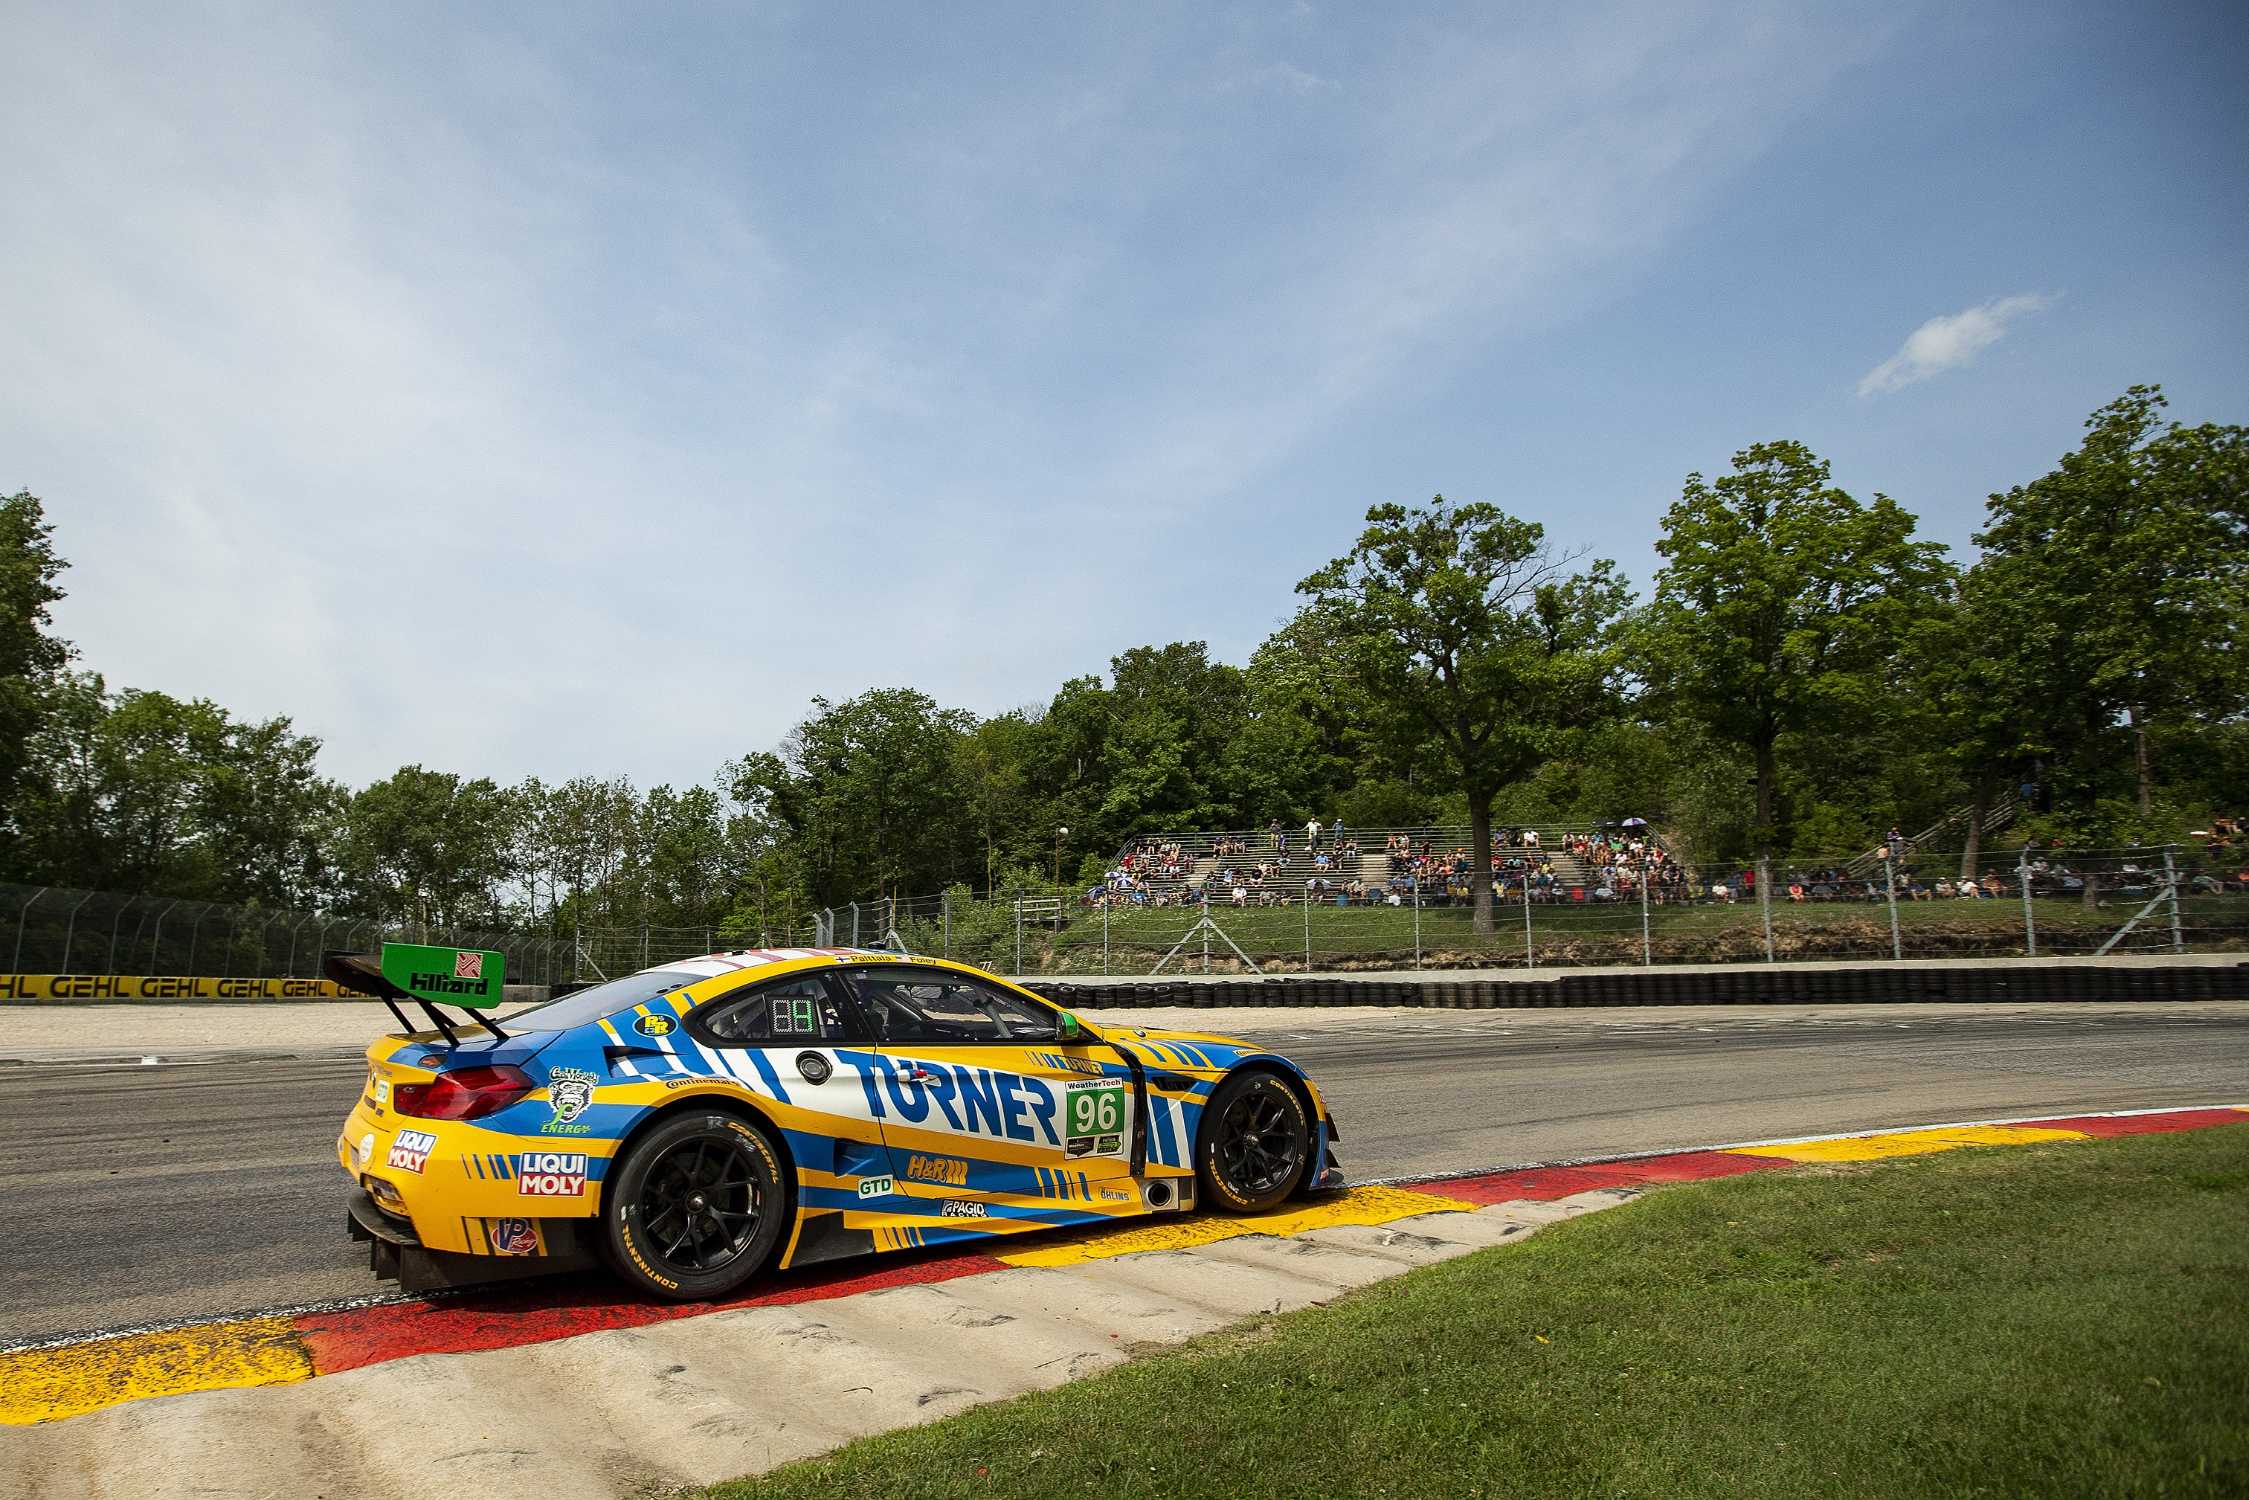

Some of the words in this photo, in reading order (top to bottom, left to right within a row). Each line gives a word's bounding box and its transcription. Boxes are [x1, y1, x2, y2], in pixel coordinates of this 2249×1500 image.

[51, 976, 129, 998] GEHL
[140, 977, 208, 998] GEHL
[217, 979, 275, 998] GEHL
[282, 981, 327, 997] GEHL
[409, 972, 488, 995] Hilliard
[1067, 1080, 1121, 1090] WeatherTech
[833, 1048, 1062, 1146] TURNER
[1076, 1092, 1117, 1133] 96
[541, 1124, 592, 1134] ENERGY
[394, 1130, 435, 1153] LIQUI
[387, 1148, 428, 1172] MOLY
[522, 1154, 585, 1174] LIQUI
[520, 1175, 584, 1195] MOLY
[860, 1179, 891, 1195] GTD
[953, 1201, 985, 1216] PAGID
